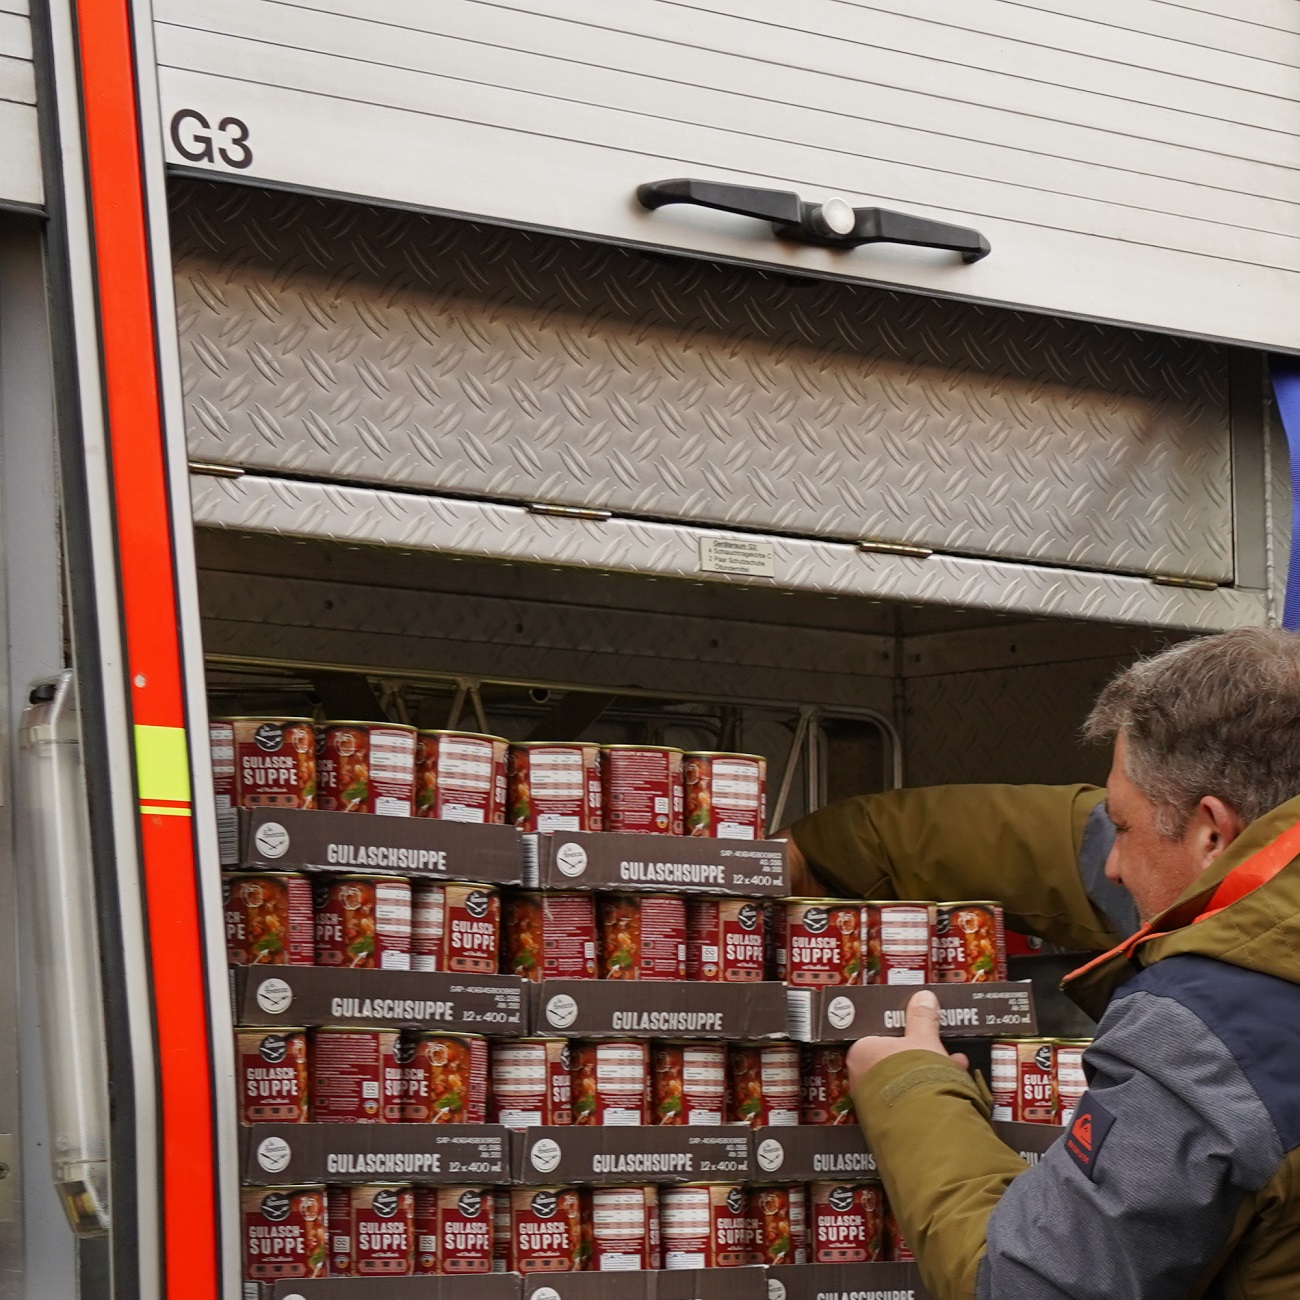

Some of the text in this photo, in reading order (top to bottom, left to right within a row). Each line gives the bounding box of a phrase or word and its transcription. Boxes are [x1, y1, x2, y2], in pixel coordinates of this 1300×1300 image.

[170, 108, 253, 169] G3
[242, 756, 297, 769] GULASCH-
[243, 768, 298, 785] SUPPE
[327, 843, 447, 870] GULASCHSUPPE
[620, 860, 726, 884] GULASCHSUPPE
[452, 932, 495, 951] SUPPE
[792, 936, 841, 949] GULASCH-
[792, 948, 841, 964] SUPPE
[331, 997, 454, 1021] GULASCHSUPPE
[612, 1011, 723, 1031] GULASCHSUPPE
[246, 1067, 298, 1080] GULASCH-
[247, 1079, 299, 1097] SUPPE
[327, 1153, 442, 1174] GULASCHSUPPE
[592, 1153, 694, 1173] GULASCHSUPPE
[817, 1215, 866, 1227] GULASCH-
[249, 1225, 305, 1238] GULASCH-
[818, 1226, 867, 1242] SUPPE
[250, 1237, 306, 1255] SUPPE
[359, 1233, 408, 1251] SUPPE
[445, 1233, 490, 1250] SUPPE
[519, 1233, 570, 1250] SUPPE
